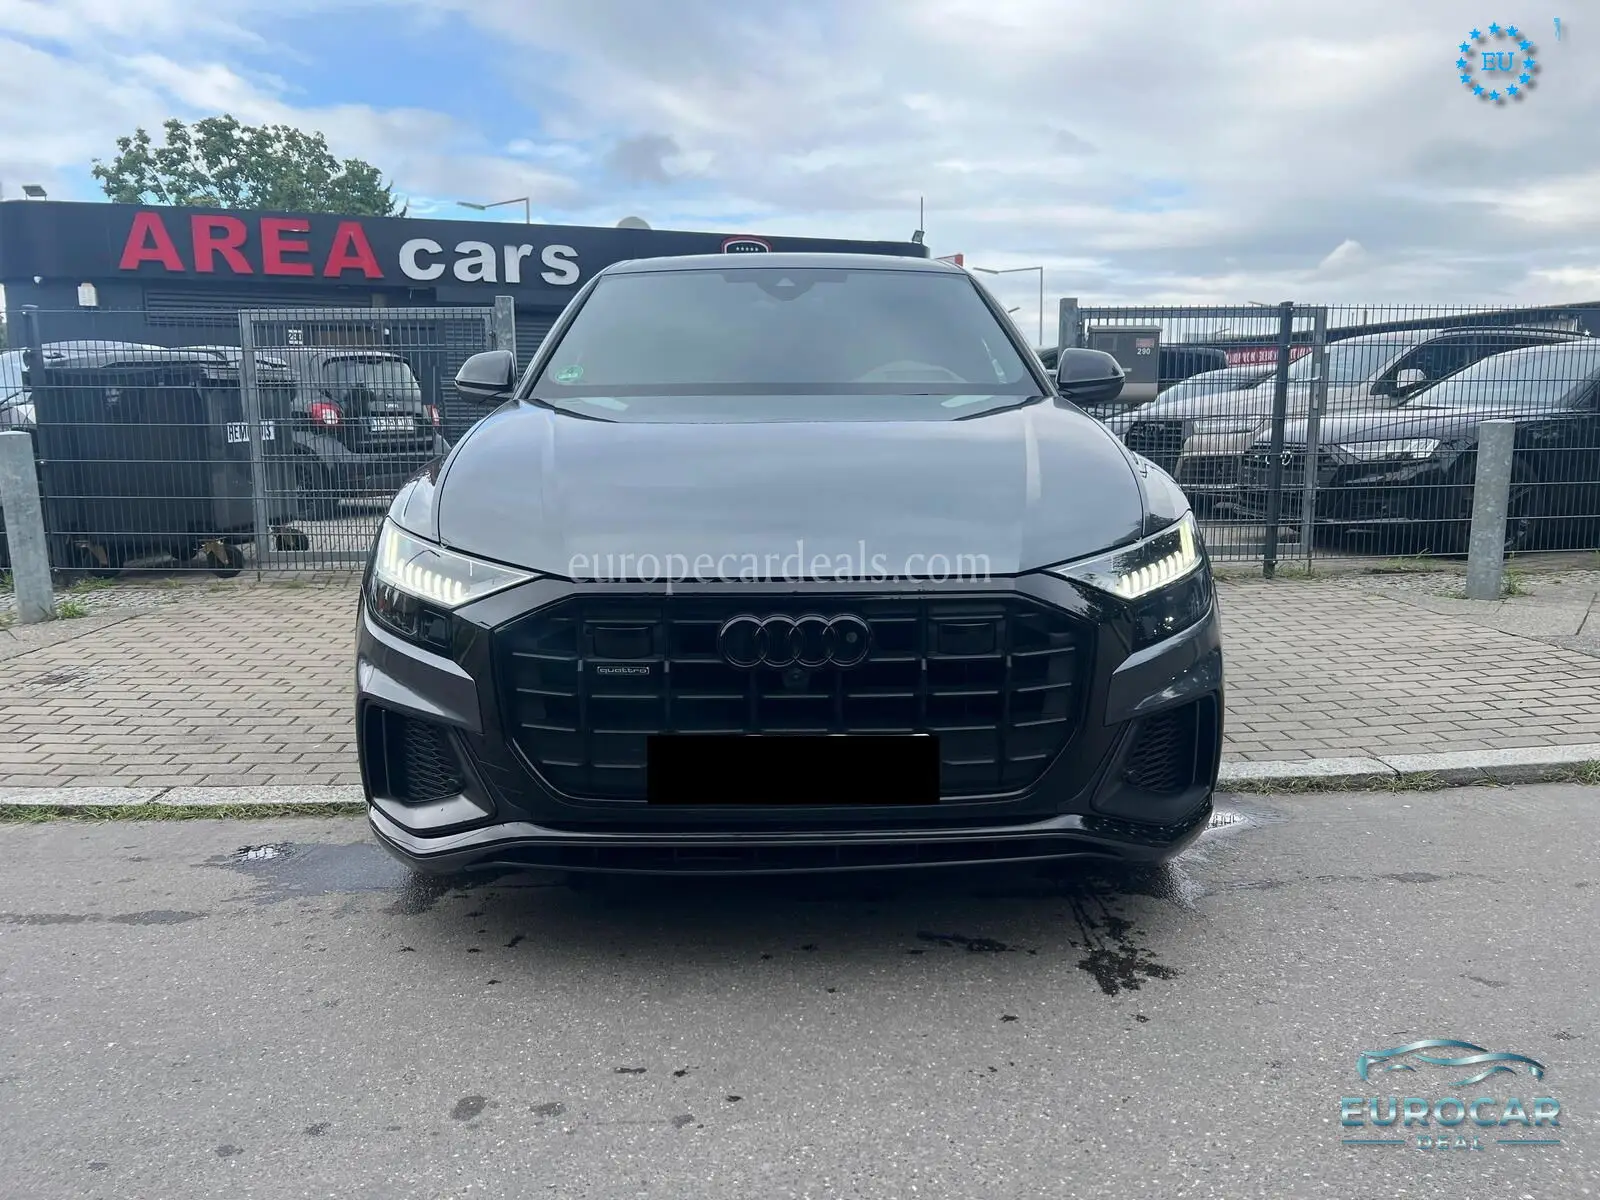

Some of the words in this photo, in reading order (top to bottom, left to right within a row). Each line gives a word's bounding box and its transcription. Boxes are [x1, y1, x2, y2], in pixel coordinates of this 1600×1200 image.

[118, 211, 384, 279] AREA
[398, 237, 580, 286] cars
[1136, 347, 1151, 355] 290
[599, 667, 648, 675] quattro
